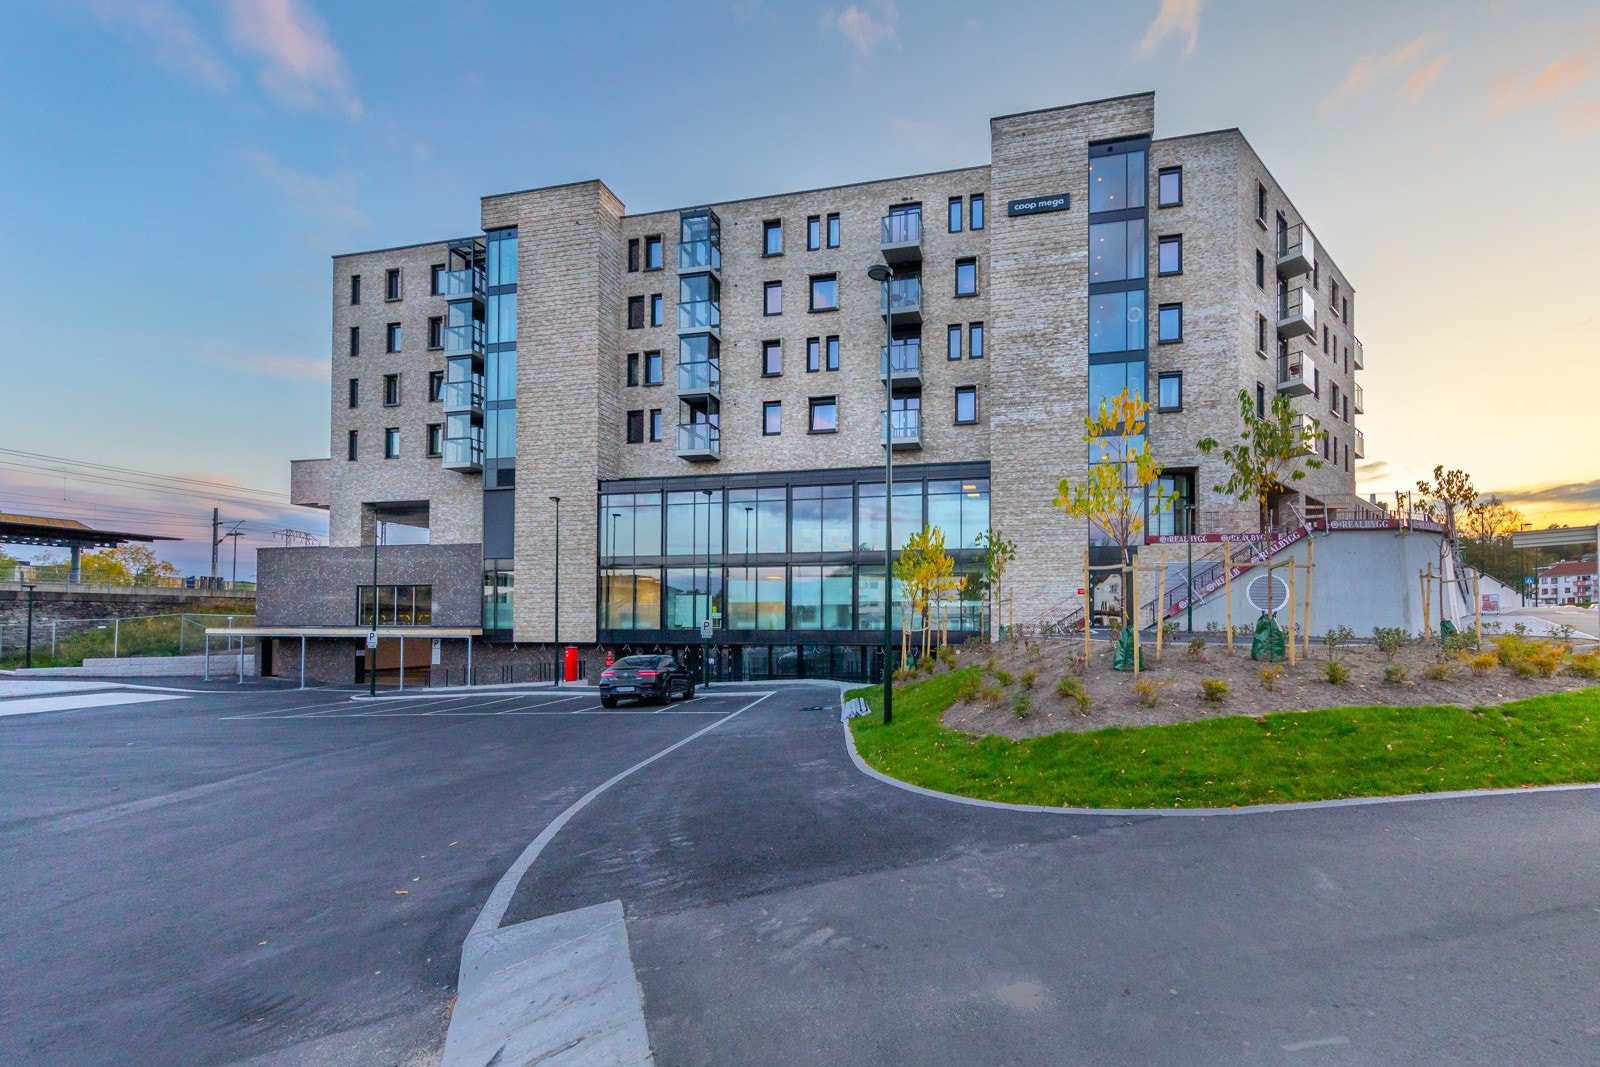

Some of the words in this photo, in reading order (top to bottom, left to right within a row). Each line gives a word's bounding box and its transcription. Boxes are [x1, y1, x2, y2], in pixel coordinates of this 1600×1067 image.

[1014, 202, 1037, 210] coop
[1038, 198, 1064, 207] mega
[1342, 520, 1389, 528] REALBYGG
[704, 621, 710, 630] P
[369, 632, 375, 641] P
